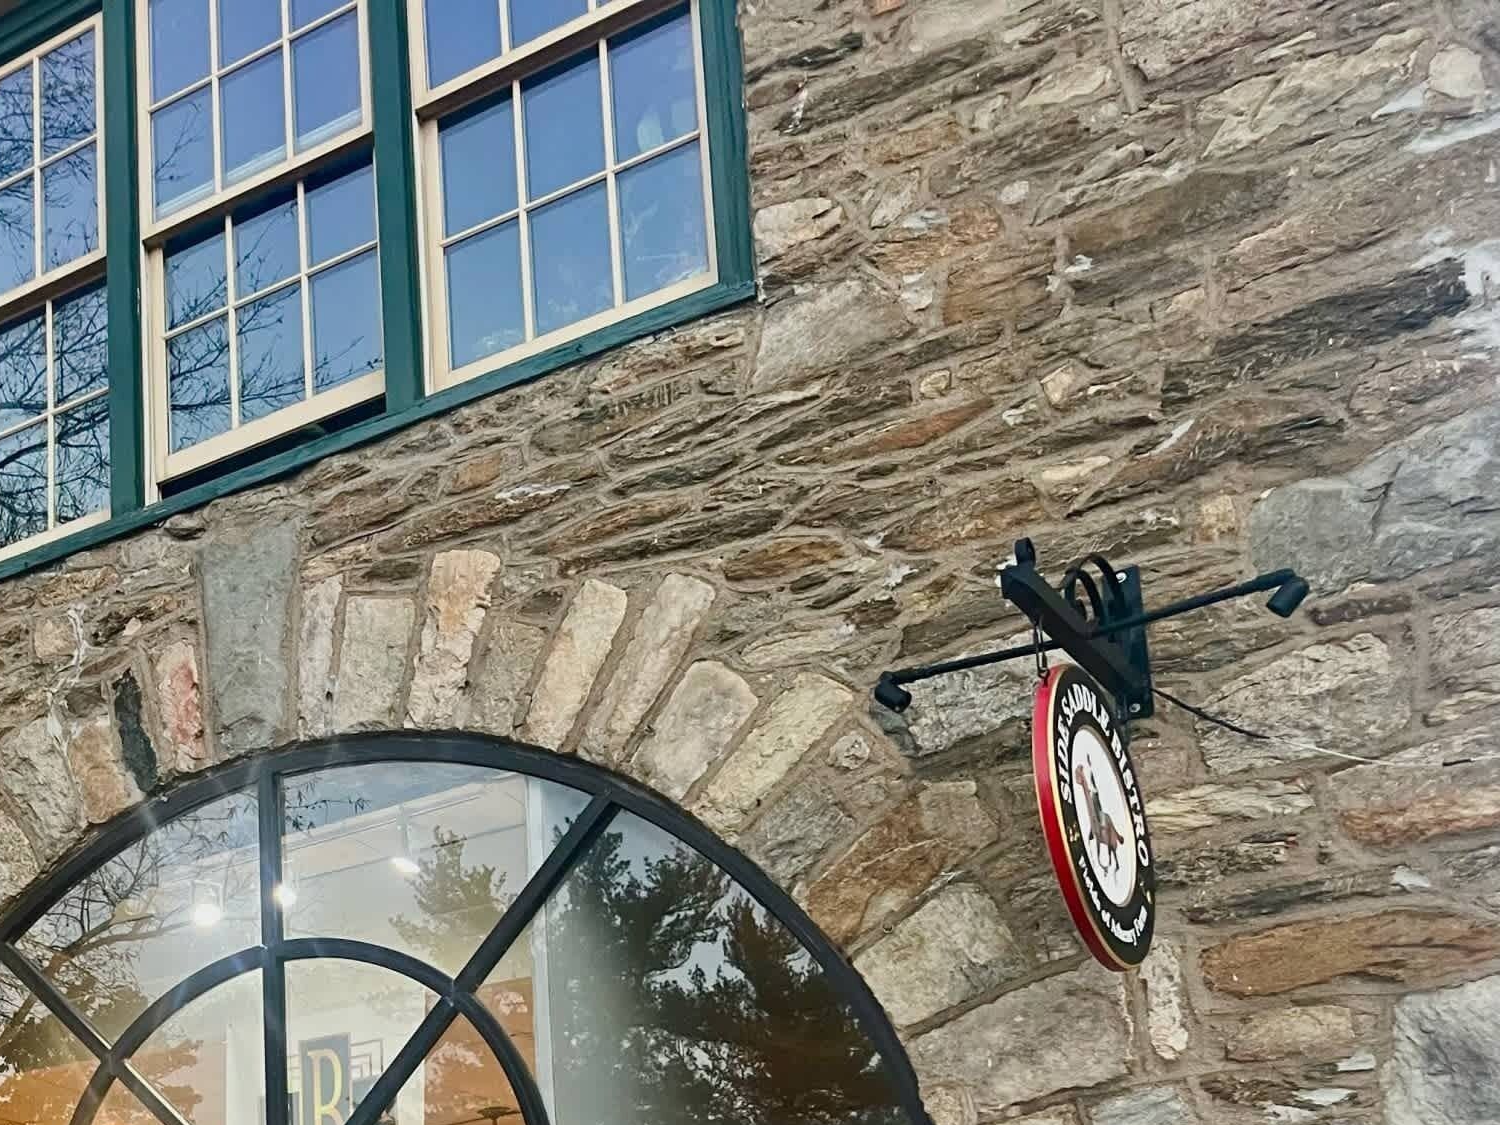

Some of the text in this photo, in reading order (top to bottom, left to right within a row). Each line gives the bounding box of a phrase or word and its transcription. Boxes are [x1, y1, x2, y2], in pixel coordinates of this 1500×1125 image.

[1057, 683, 1149, 867] SIDE SADDLE BISTRO
